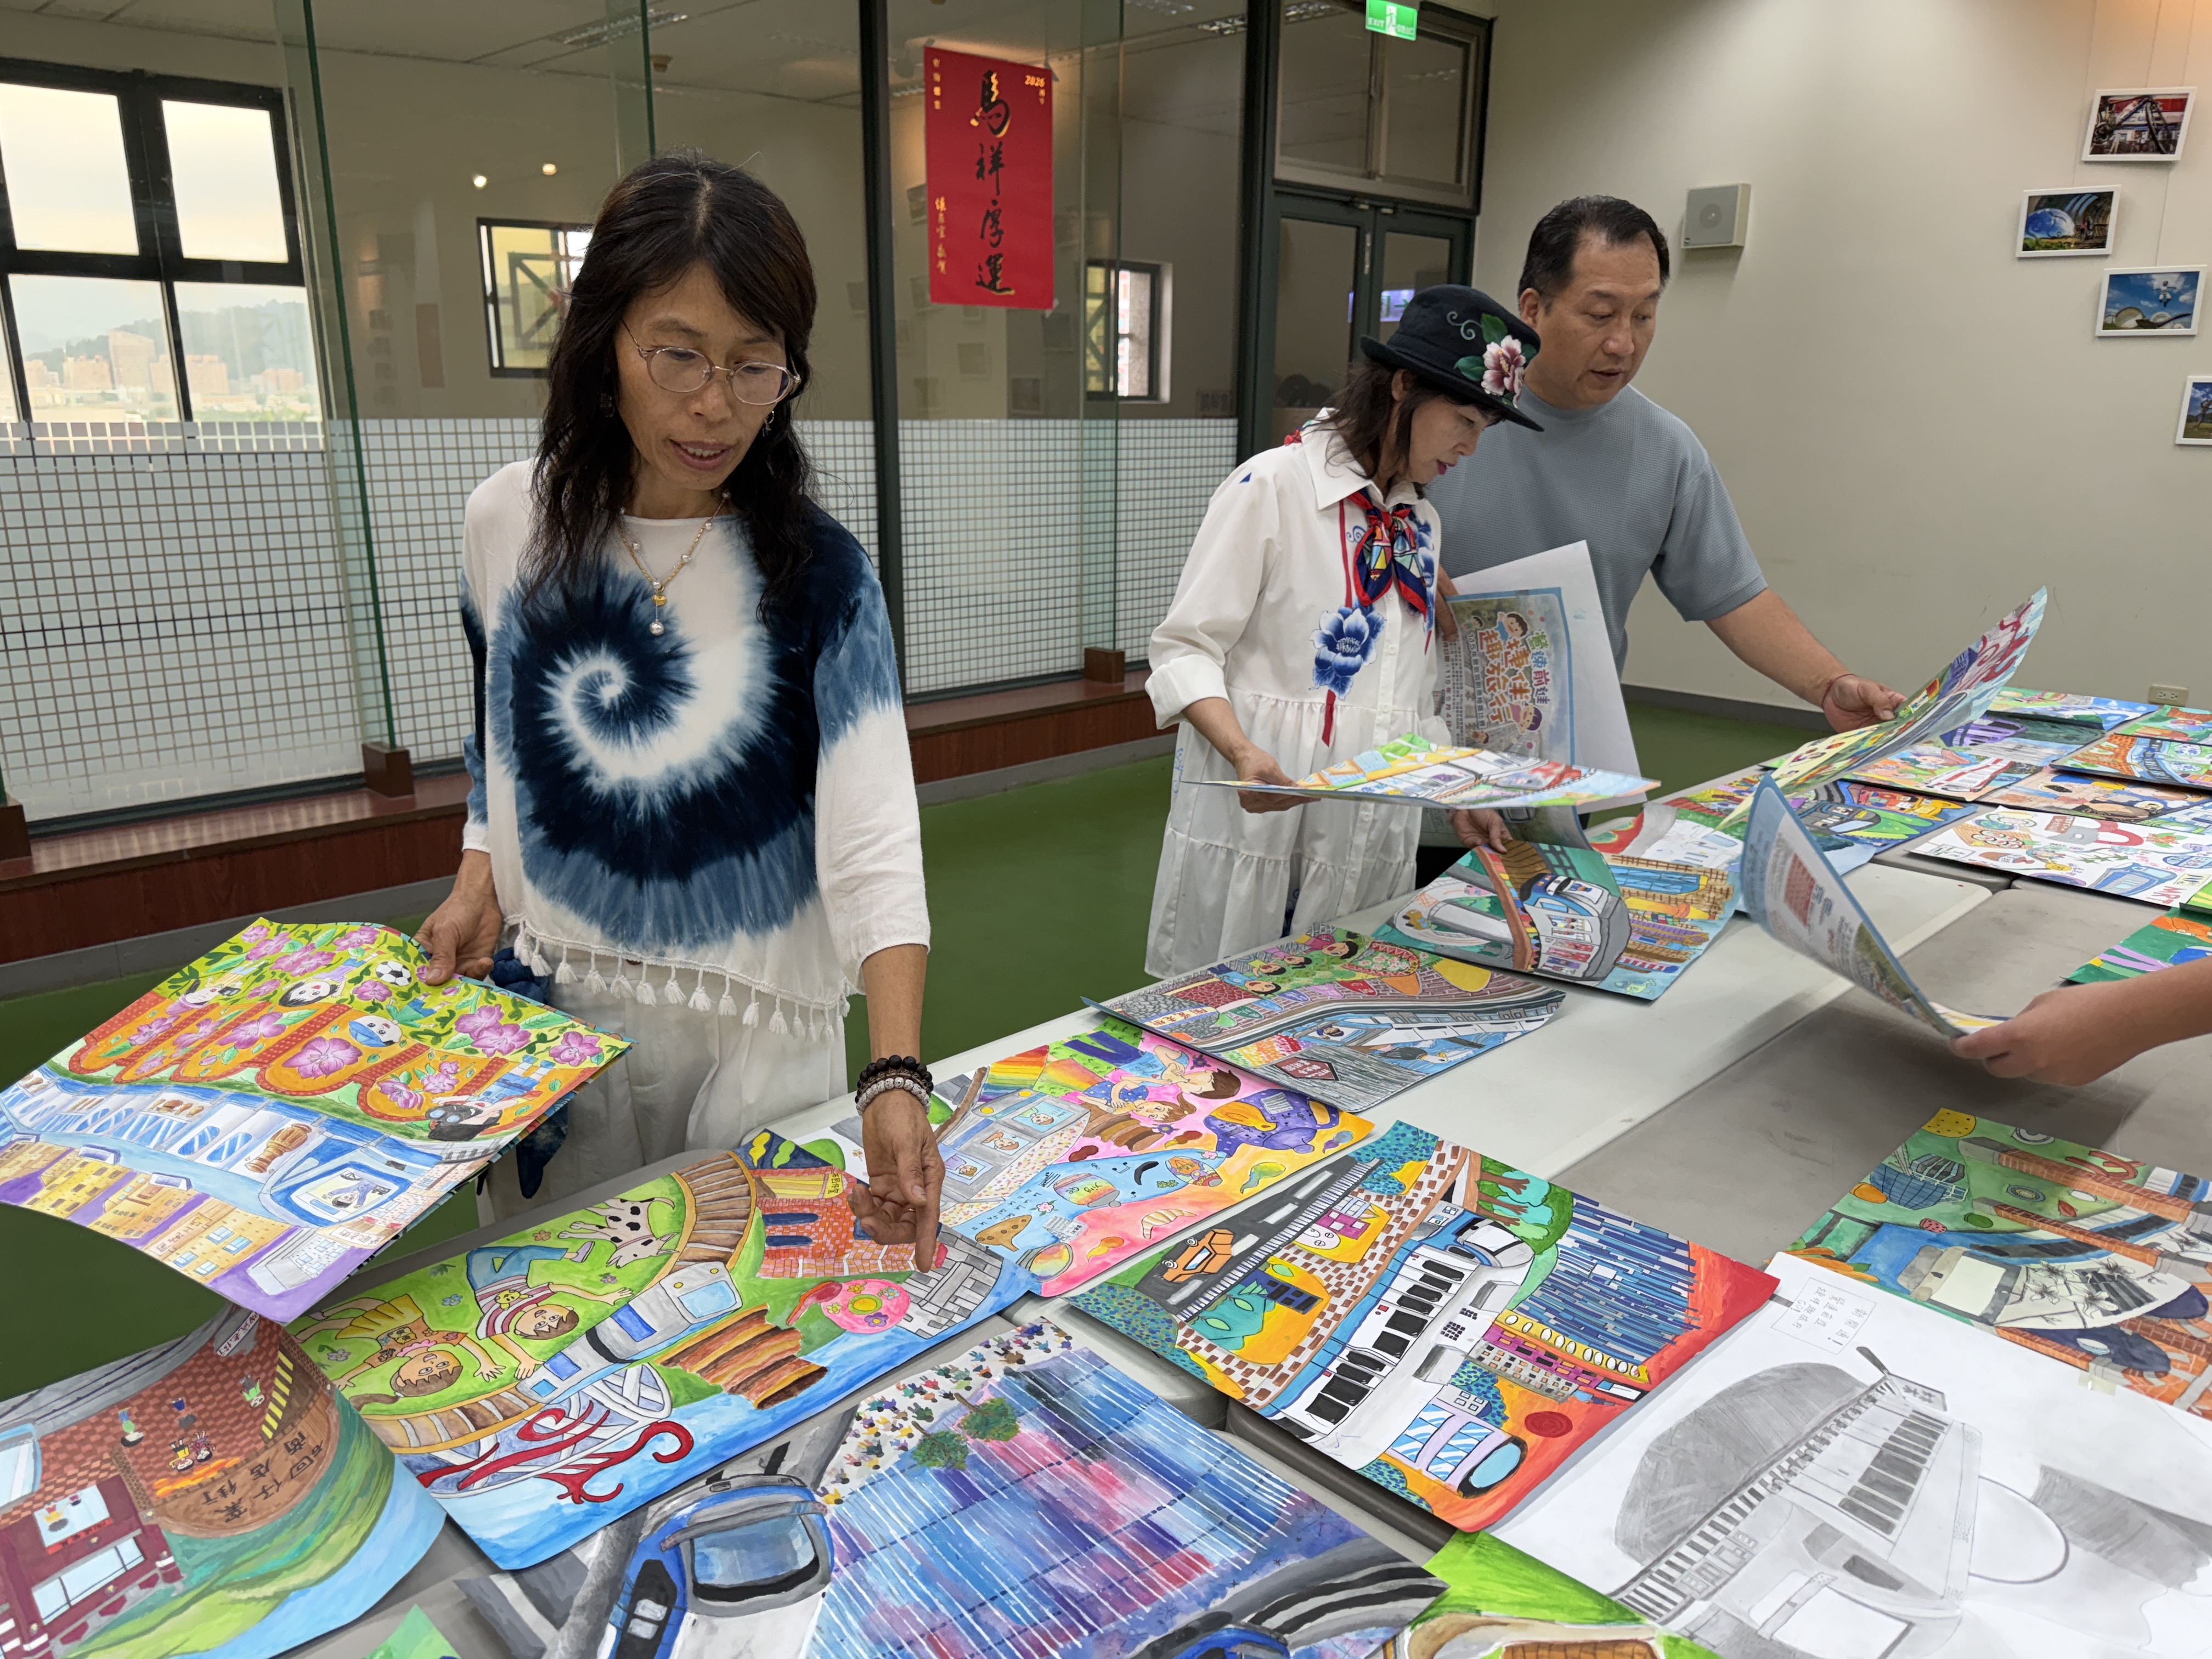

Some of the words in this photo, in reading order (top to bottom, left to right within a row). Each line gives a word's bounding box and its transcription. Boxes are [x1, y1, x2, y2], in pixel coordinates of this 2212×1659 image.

[1368, 17, 1385, 28] EXIT
[1024, 75, 1045, 88] 2026
[1479, 629, 1511, 723] 趣旅行
[1504, 638, 1531, 701] 捷伴
[2146, 885, 2187, 904] MRT
[202, 1431, 306, 1506] 商店街
